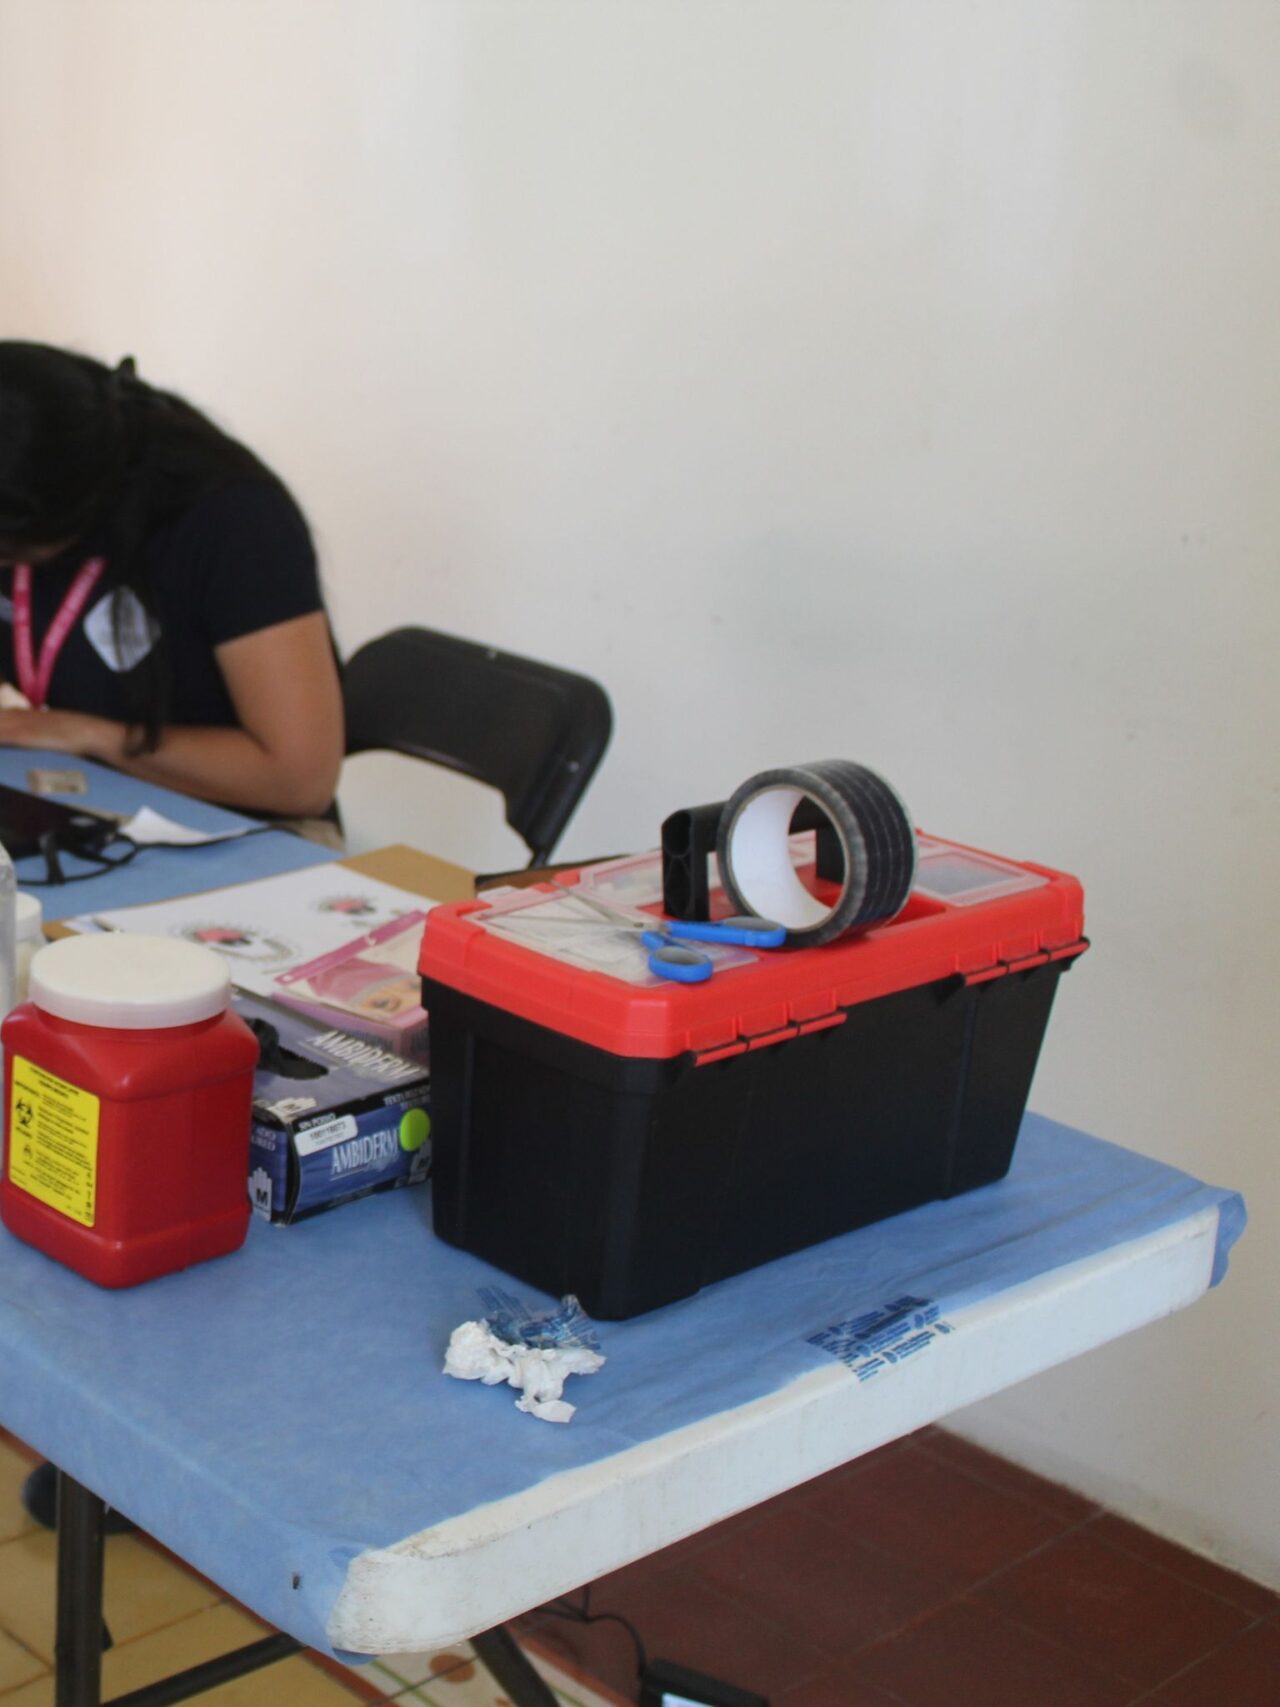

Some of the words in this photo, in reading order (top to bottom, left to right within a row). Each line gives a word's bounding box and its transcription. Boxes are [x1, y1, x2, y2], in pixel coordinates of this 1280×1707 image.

[305, 1030, 420, 1080] AMBIDERM
[331, 1128, 399, 1174] AMBIDERM
[255, 1187, 269, 1205] M
